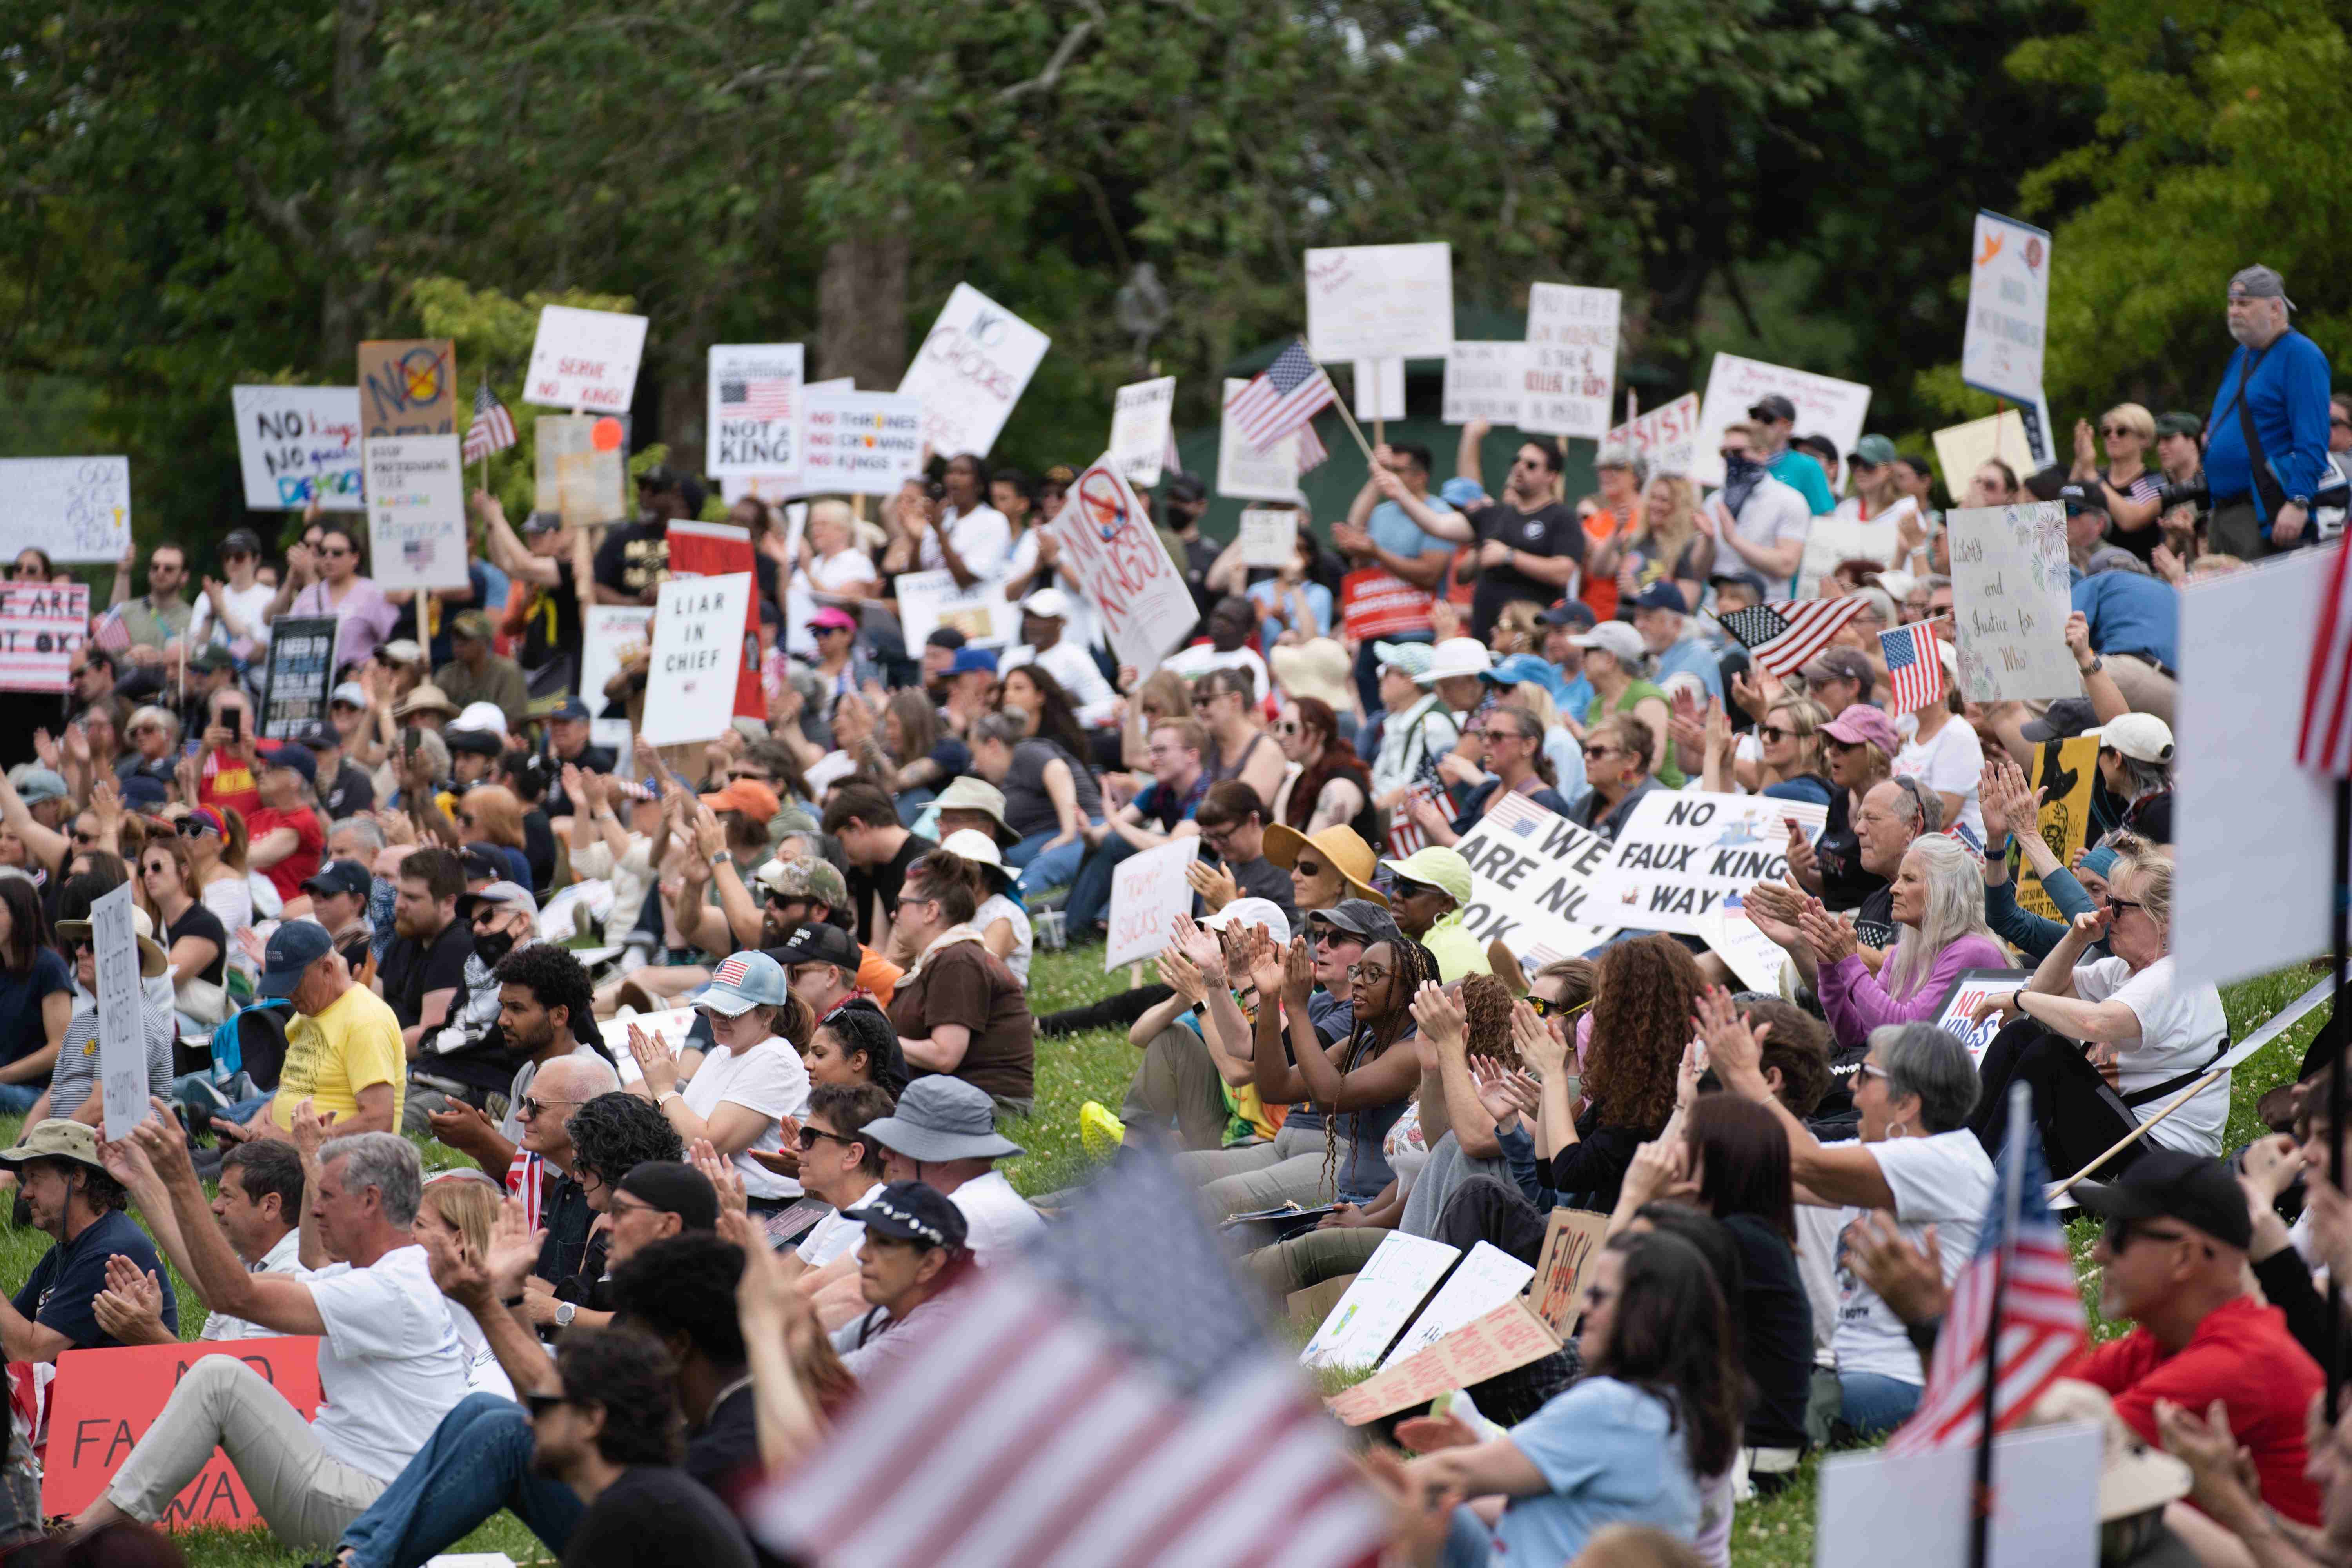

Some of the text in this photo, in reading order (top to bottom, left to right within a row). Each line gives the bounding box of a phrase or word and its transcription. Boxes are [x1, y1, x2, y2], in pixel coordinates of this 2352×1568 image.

[257, 410, 303, 440] NO
[722, 420, 771, 438] NOT
[264, 446, 305, 479] NO
[719, 440, 790, 464] KING
[1985, 571, 2004, 598] and
[30, 589, 84, 618] ARE
[675, 593, 725, 615] LIAR
[684, 622, 705, 642] IN
[1972, 608, 2035, 637] Justice for
[666, 649, 720, 673] CHIEF
[1666, 800, 1716, 827] NO
[1456, 834, 1540, 891] ARE
[1539, 819, 1612, 877] WE
[1616, 842, 1788, 880] FAUX KING
[1534, 877, 1605, 935] NO
[2036, 902, 2044, 916] IS
[1463, 903, 1523, 942] OK
[1951, 991, 1985, 1017] NO
[1544, 1225, 1593, 1294] FUCK
